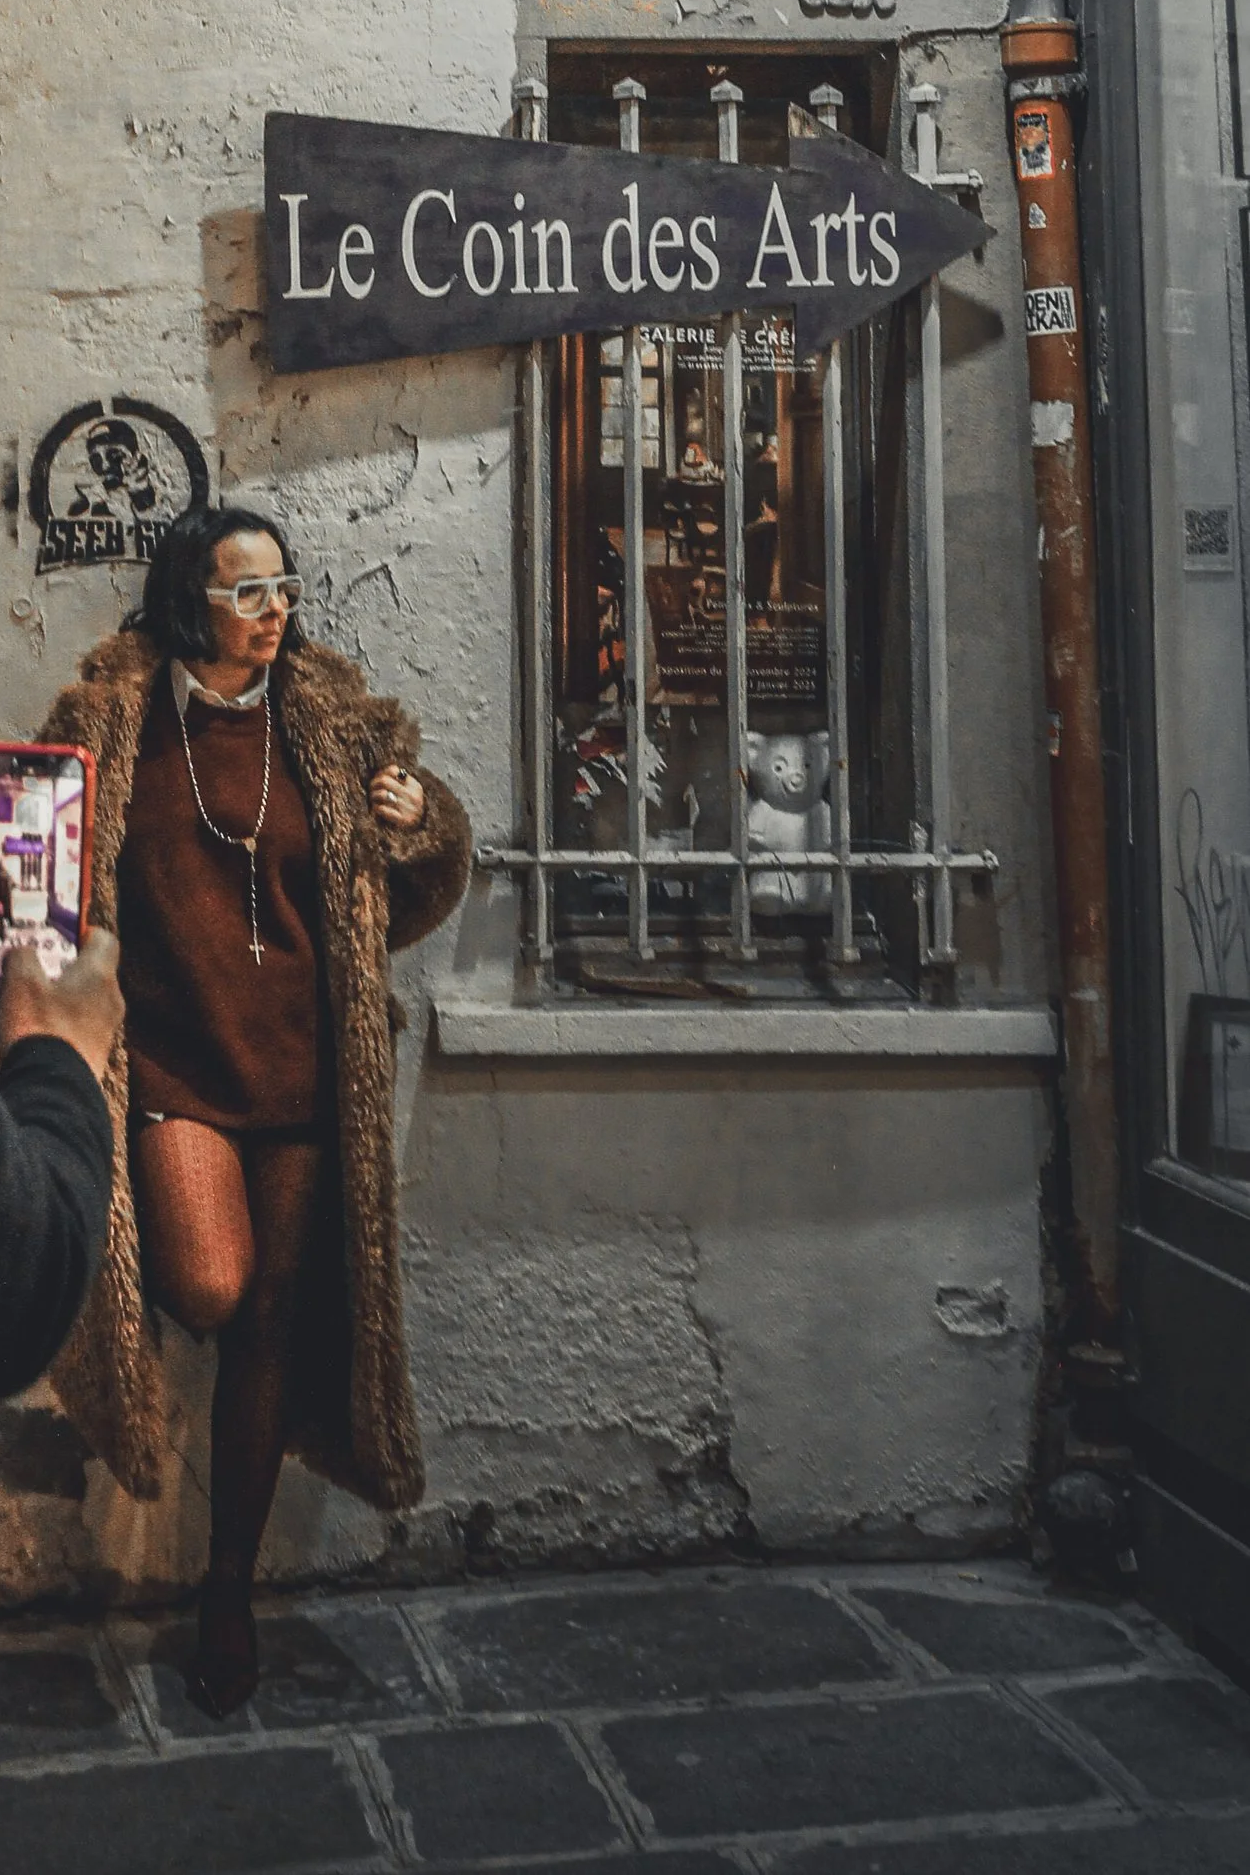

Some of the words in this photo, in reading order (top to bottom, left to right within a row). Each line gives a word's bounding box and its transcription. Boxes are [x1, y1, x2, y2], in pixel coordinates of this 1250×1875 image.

[279, 192, 376, 300] Le
[401, 188, 580, 299] Coin
[602, 181, 722, 294] des
[745, 180, 902, 291] Arts
